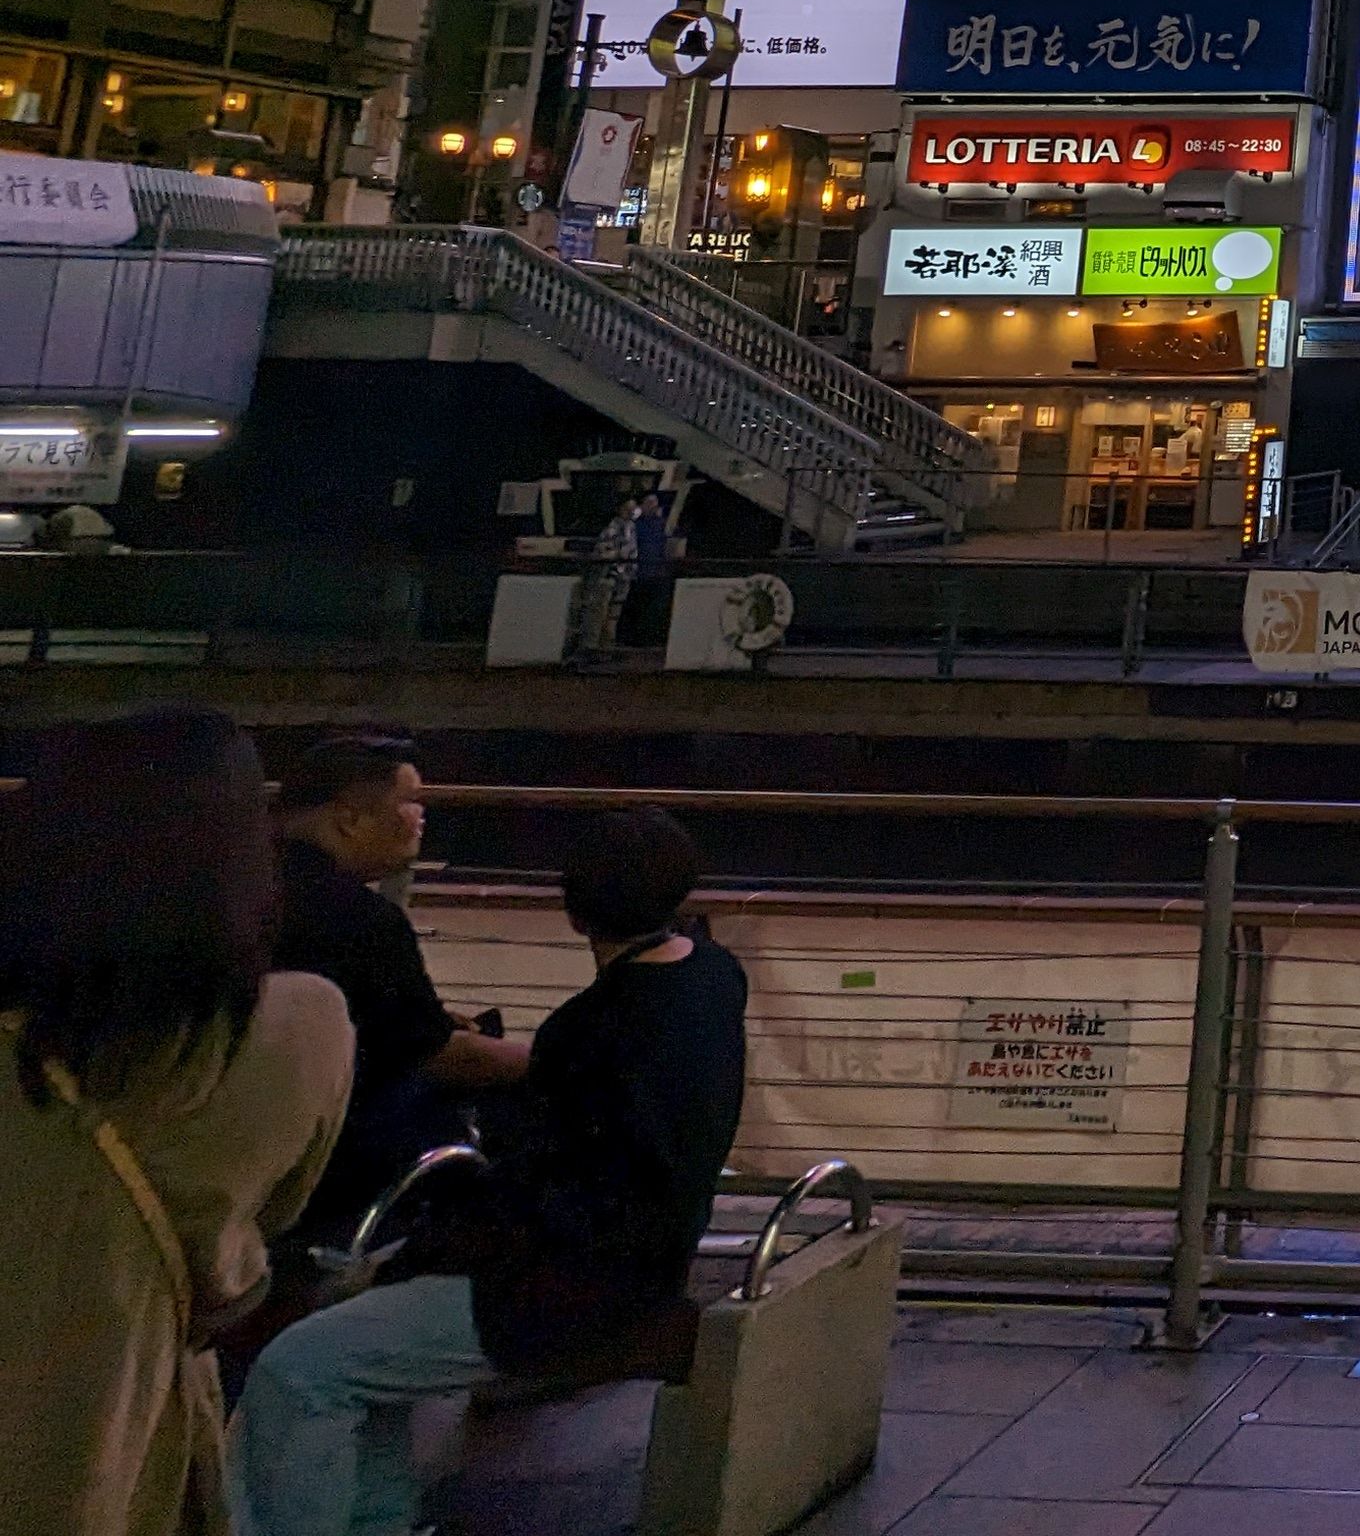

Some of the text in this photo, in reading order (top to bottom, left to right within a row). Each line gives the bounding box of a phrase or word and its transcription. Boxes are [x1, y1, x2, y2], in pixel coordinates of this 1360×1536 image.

[924, 137, 1121, 165] LOTTERIA
[1140, 245, 1207, 277] ピタットハウス
